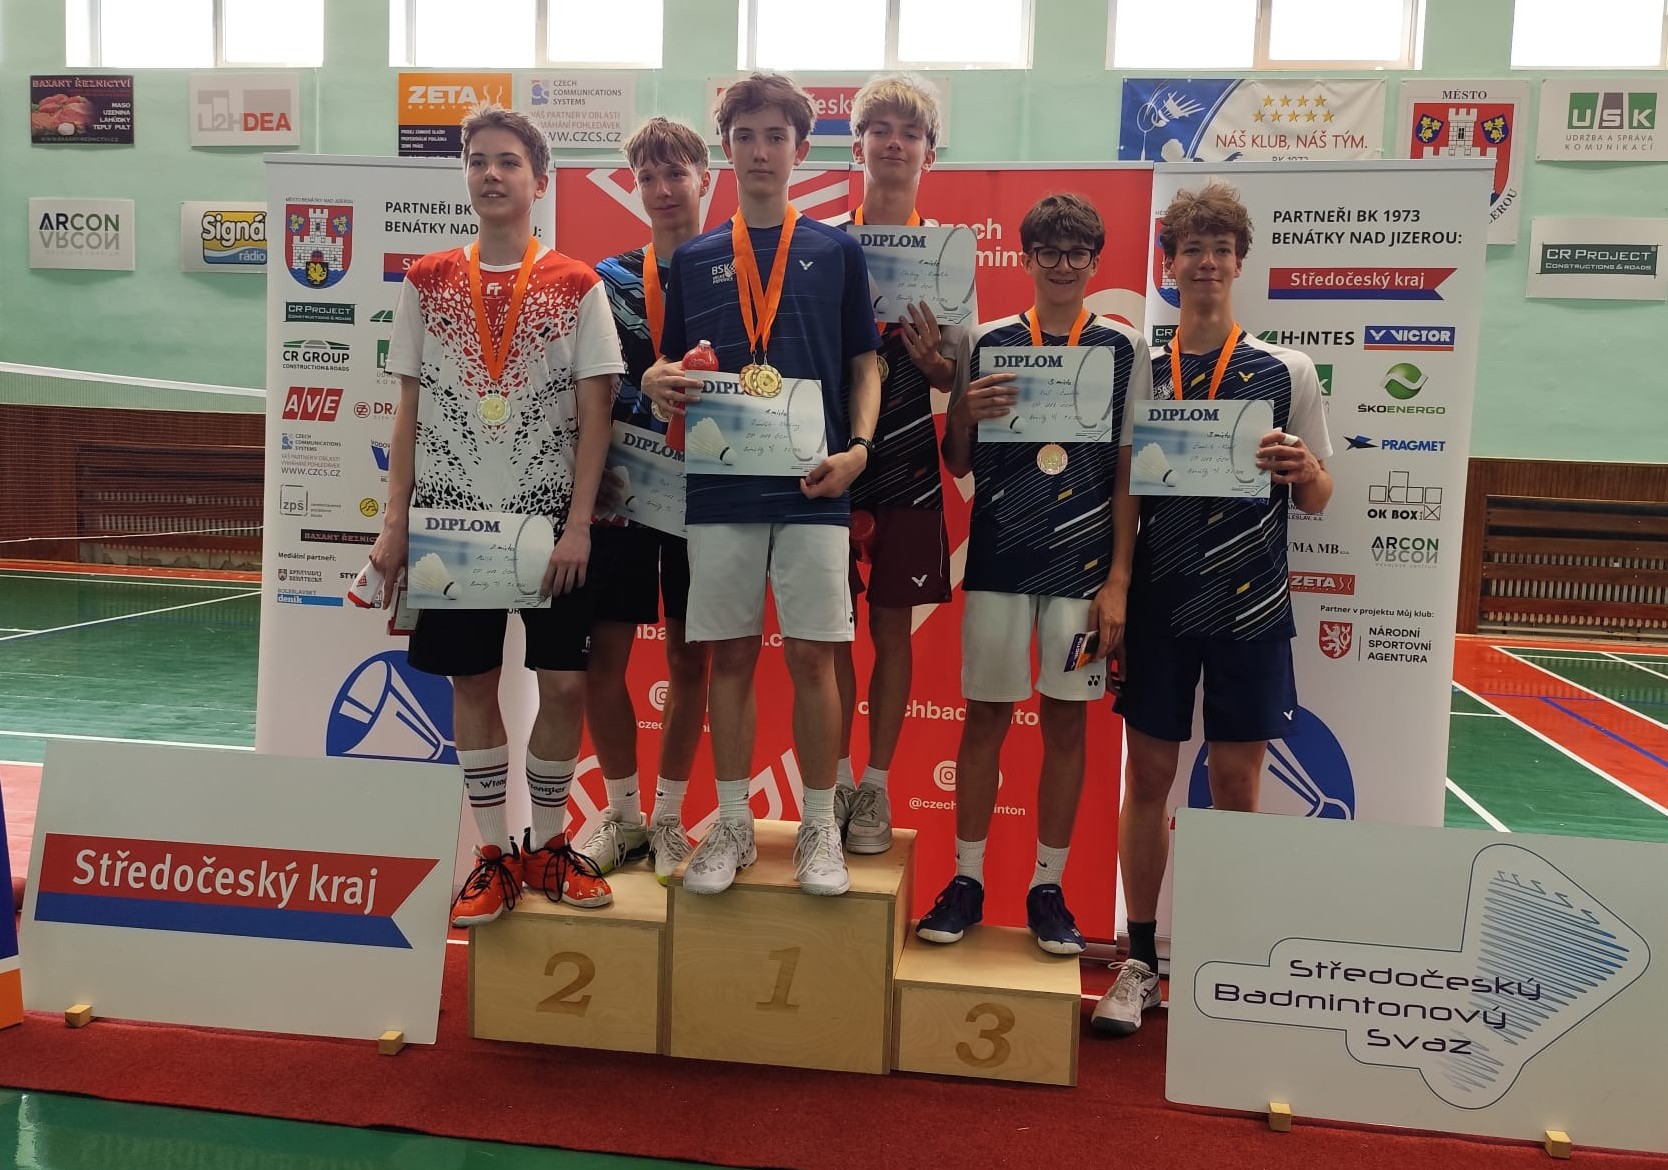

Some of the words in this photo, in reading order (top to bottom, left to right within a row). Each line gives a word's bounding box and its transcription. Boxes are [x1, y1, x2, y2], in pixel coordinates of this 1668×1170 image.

[75, 77, 131, 88] ŘEZNICTVÍ
[408, 85, 478, 104] ZETA
[1442, 88, 1487, 100] MĚSTO
[547, 111, 580, 119] PARTNER
[588, 111, 621, 119] OBLASTI
[1572, 109, 1653, 128] USK
[1216, 130, 1246, 149] NÁŠ
[1251, 134, 1290, 150] KLUB,
[1296, 130, 1327, 149] NÁŠ
[1332, 129, 1368, 149] TÝM.
[1607, 134, 1614, 142] A
[1617, 133, 1653, 142] SPRÁVA
[1565, 142, 1653, 151] KOMUNIKACÍ
[385, 201, 450, 215] PARTNEŘI
[455, 204, 472, 215] BK
[1273, 207, 1351, 223] PARTNEŘI
[1356, 210, 1378, 222] BK
[1383, 209, 1420, 222] 1973
[39, 213, 120, 232] ARCON
[385, 219, 446, 234] BENÁTKY
[450, 223, 479, 235] NAD
[201, 213, 266, 248] Signá
[860, 233, 926, 248] DIPLOM
[1271, 229, 1345, 244] BENÁTKY
[1349, 231, 1386, 244] NAD
[1389, 231, 1462, 247] JIZEROU:
[239, 251, 266, 262] rádio
[1546, 249, 1571, 260] CR
[1575, 249, 1652, 261] PROJECT
[1290, 271, 1390, 290] Středočeský
[1394, 272, 1425, 289] kraj
[288, 305, 303, 313] CR
[1155, 328, 1172, 337] CR
[1281, 331, 1355, 346] H-INTES
[1389, 329, 1451, 342] VICTOR
[283, 350, 298, 361] CR
[302, 351, 350, 363] GROUP
[994, 355, 1063, 368] DIPLOM
[701, 380, 745, 396] DIPL
[285, 396, 340, 414] AVE
[1357, 402, 1446, 415] ŠKOENERGO
[1148, 408, 1219, 422] DIPLOM
[622, 431, 686, 463] DIPLOM
[1381, 439, 1446, 452] PRAGMET
[281, 467, 341, 477] WWW.CZCS.CZ
[283, 500, 304, 513] zpš
[1367, 508, 1387, 519] OK
[1391, 509, 1418, 520] BOX
[425, 517, 501, 533] DIPLOM
[1286, 541, 1313, 553] YMA
[1317, 543, 1339, 554] MB
[1371, 536, 1439, 550] ARCON
[278, 552, 305, 560] Mediální
[1291, 575, 1335, 588] ZETA
[1320, 604, 1351, 613] Partner
[1359, 607, 1395, 617] projektu
[1396, 608, 1411, 618] Můj
[1413, 609, 1434, 618] klub:
[1369, 625, 1420, 638] NÁRODNÍ
[1368, 638, 1432, 651] SPORTOVNÍ
[1367, 652, 1428, 664] AGENTURA
[72, 847, 300, 909] Středočeský
[308, 863, 378, 915] kraj
[536, 951, 597, 1018] 2
[756, 946, 801, 1012] 1
[1289, 958, 1542, 1001] Středočeský
[1214, 982, 1506, 1030] Badmintonový
[955, 1002, 1016, 1069] 3
[1367, 1028, 1472, 1056] Svaz
